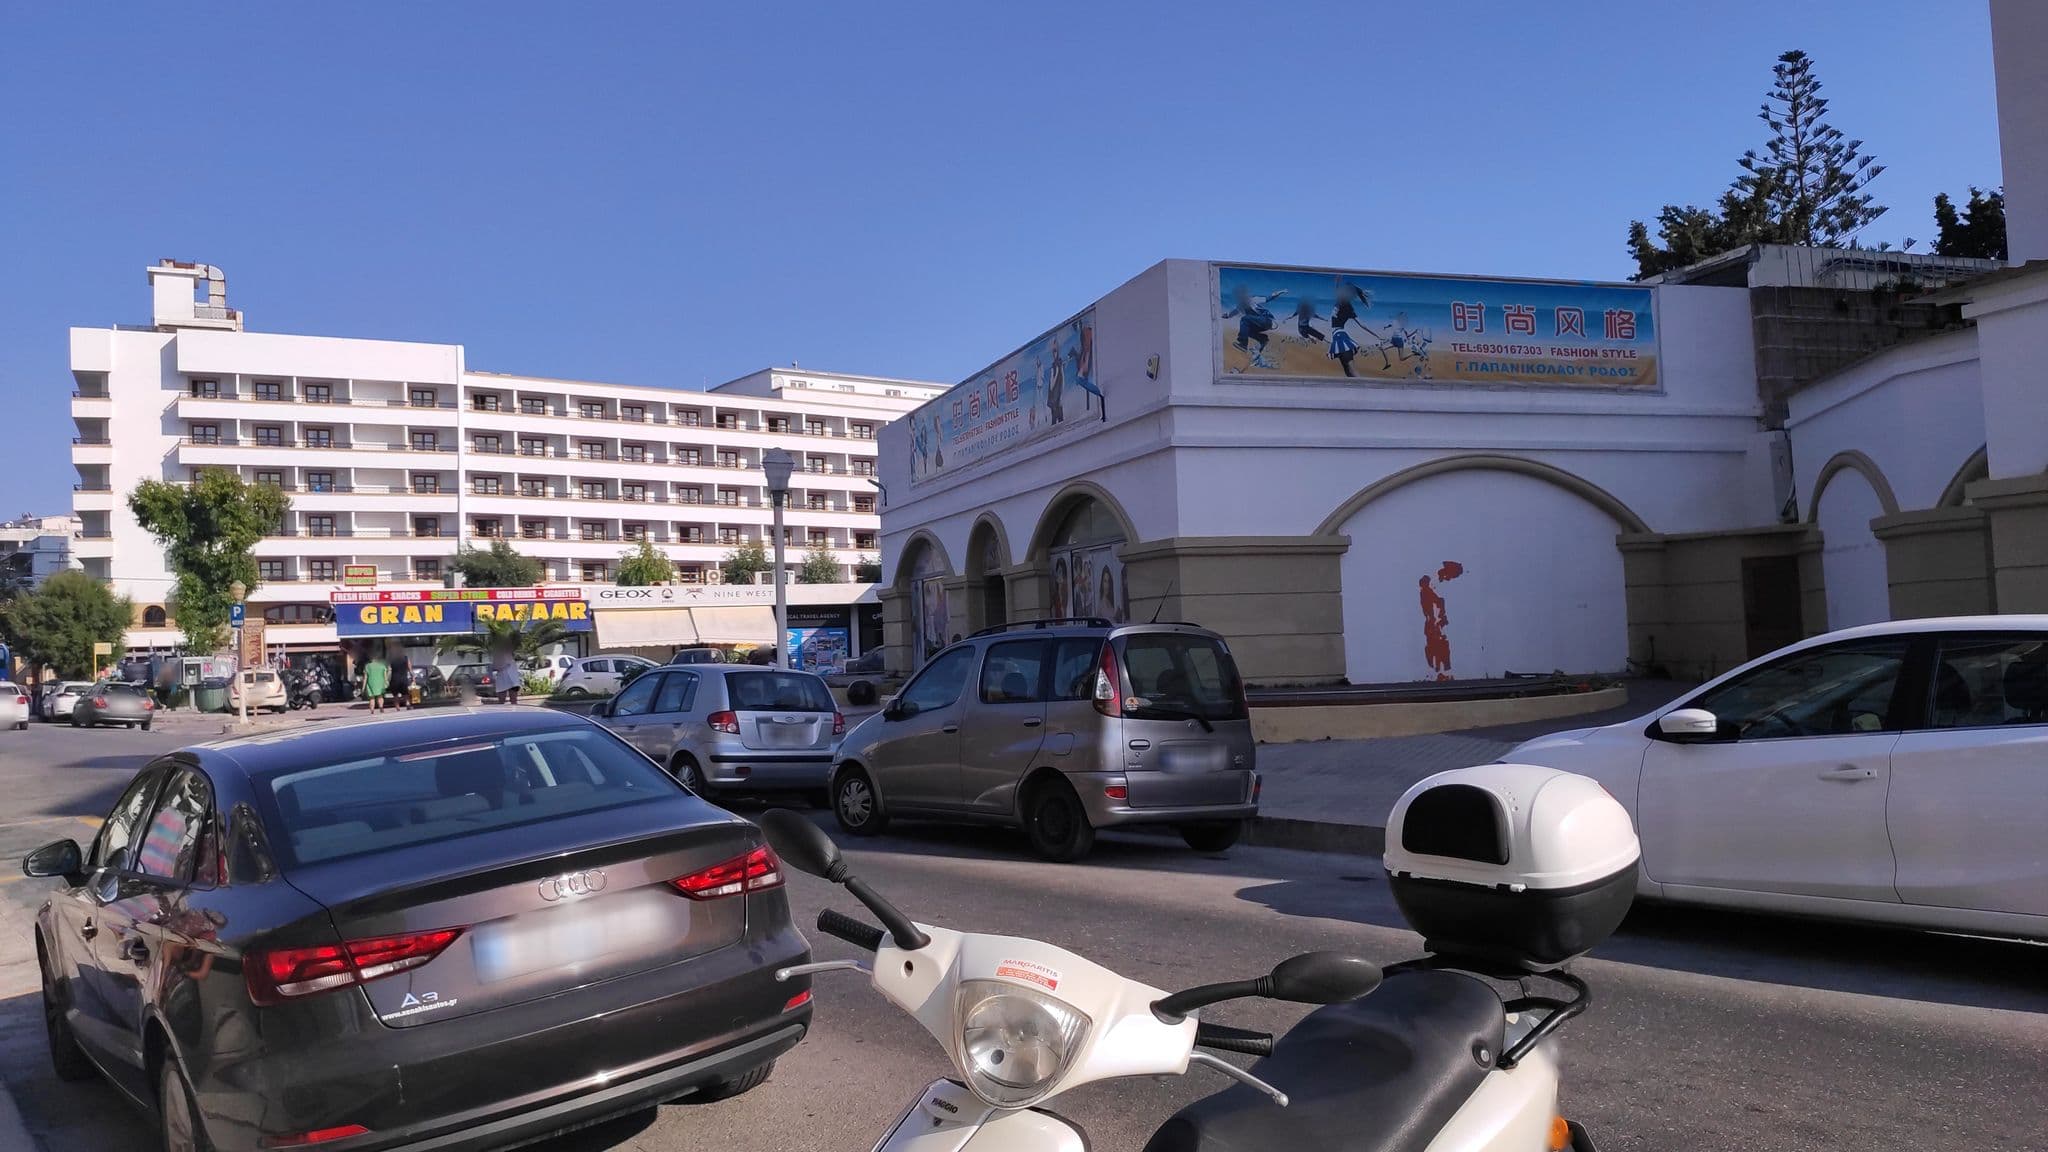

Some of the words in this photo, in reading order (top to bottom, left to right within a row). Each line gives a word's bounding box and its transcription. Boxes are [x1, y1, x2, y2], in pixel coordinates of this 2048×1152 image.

[1451, 301, 1637, 341] 时尚风格
[1451, 343, 1543, 356] TEL:6930167303
[1550, 347, 1599, 358] FASHION
[1602, 349, 1637, 359] STYLE
[359, 592, 380, 600] FRUIT
[430, 591, 459, 600] SUPER
[600, 589, 652, 599] GEOX
[233, 606, 241, 617] P
[361, 604, 443, 624] GRAN
[477, 602, 587, 621] BAZAAR
[401, 992, 438, 1008] A3
